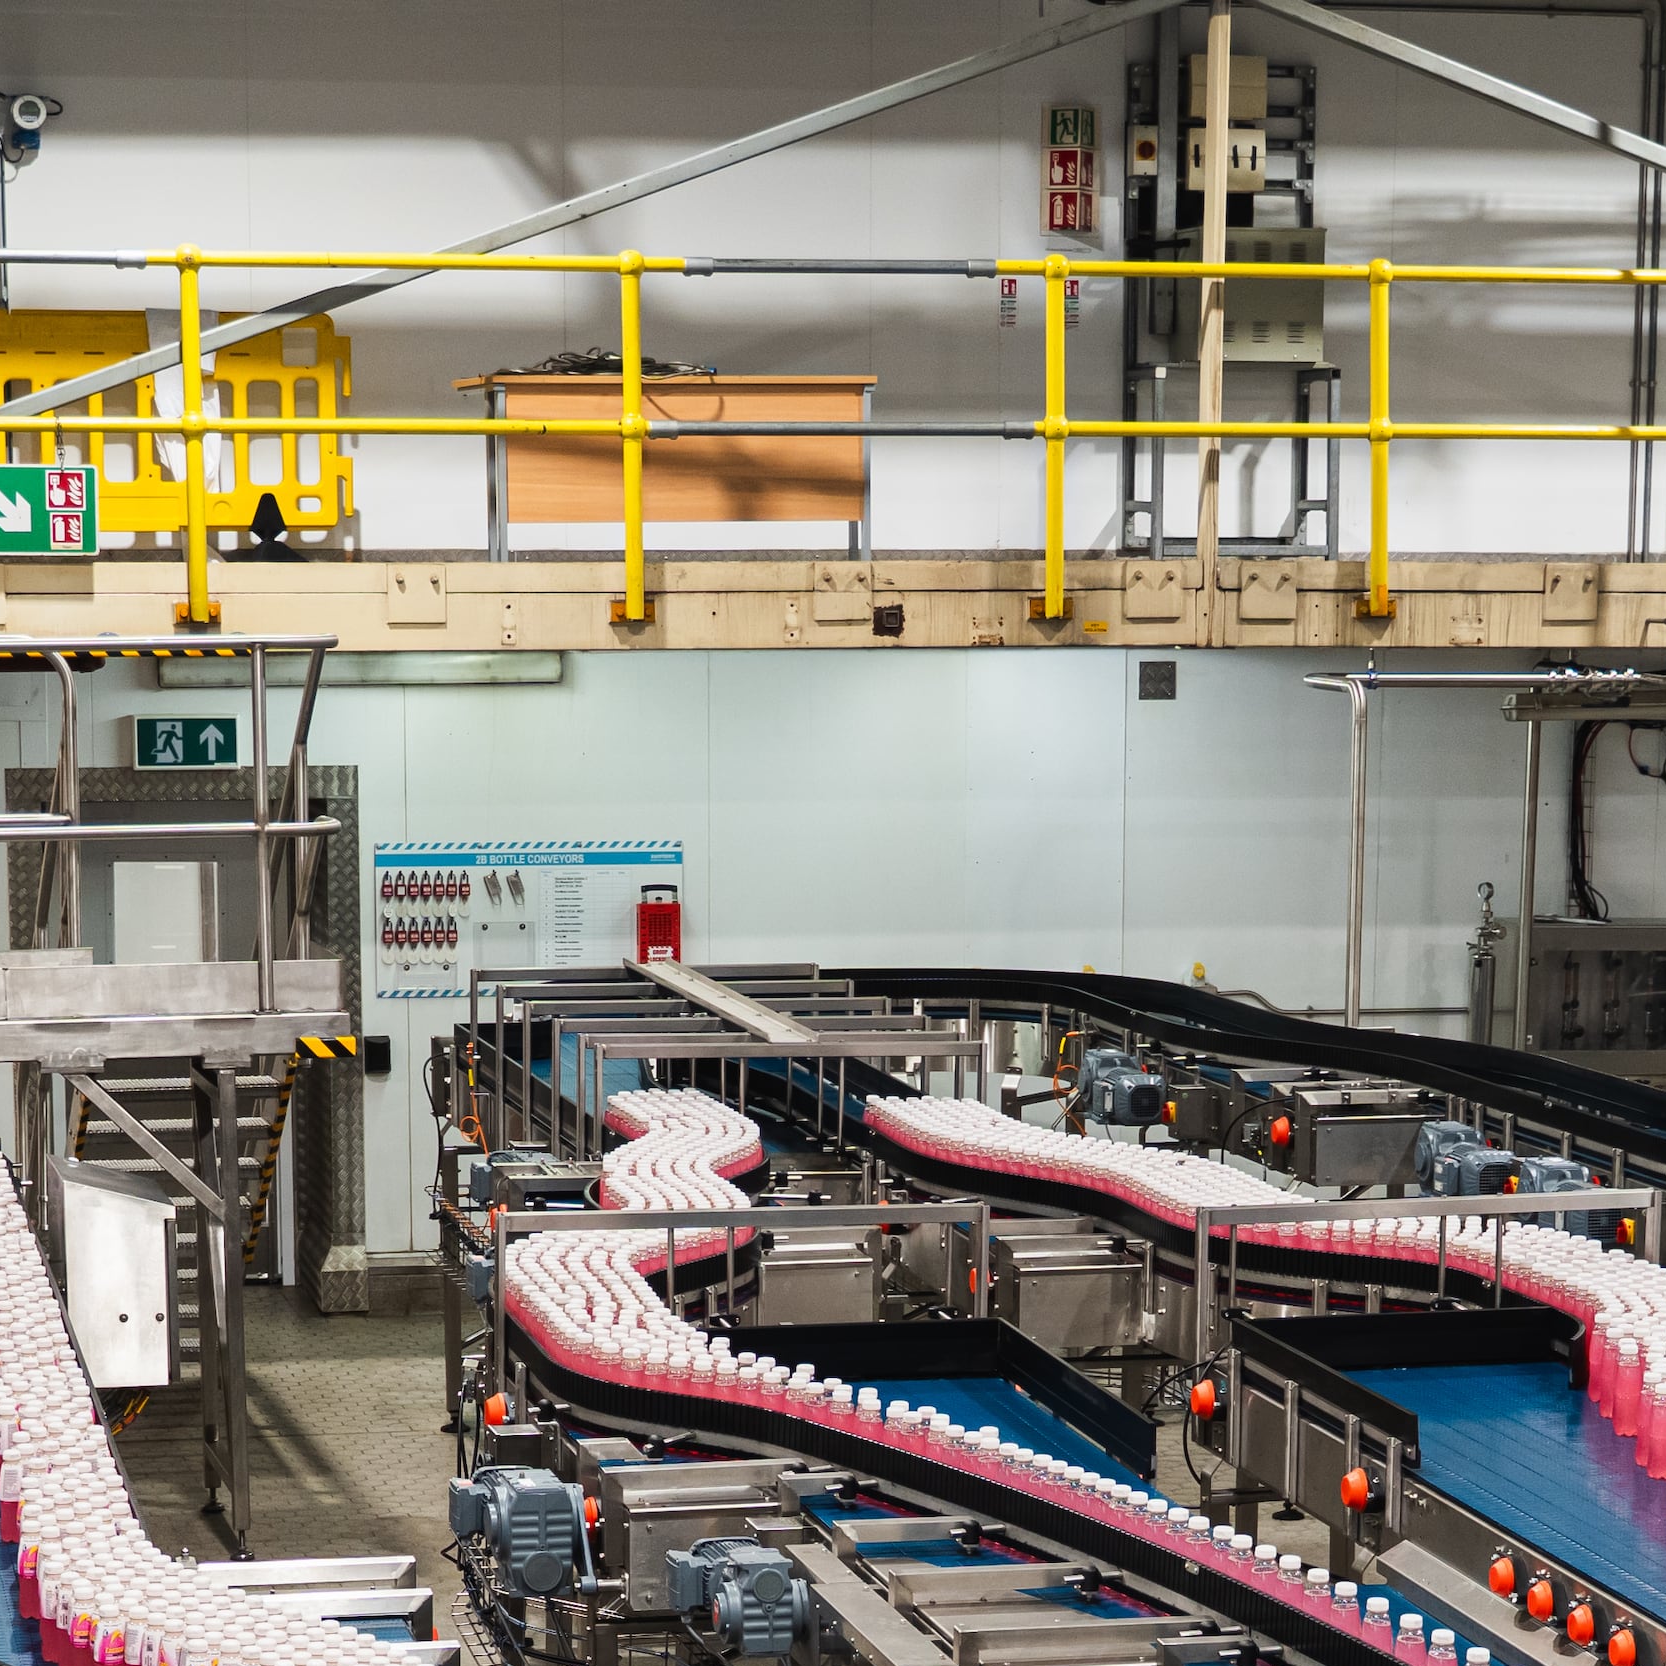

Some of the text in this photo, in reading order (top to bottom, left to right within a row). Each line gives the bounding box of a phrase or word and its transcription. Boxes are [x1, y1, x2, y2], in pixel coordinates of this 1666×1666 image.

[475, 853, 585, 865] 2B BOTTLE CONVEYORS
